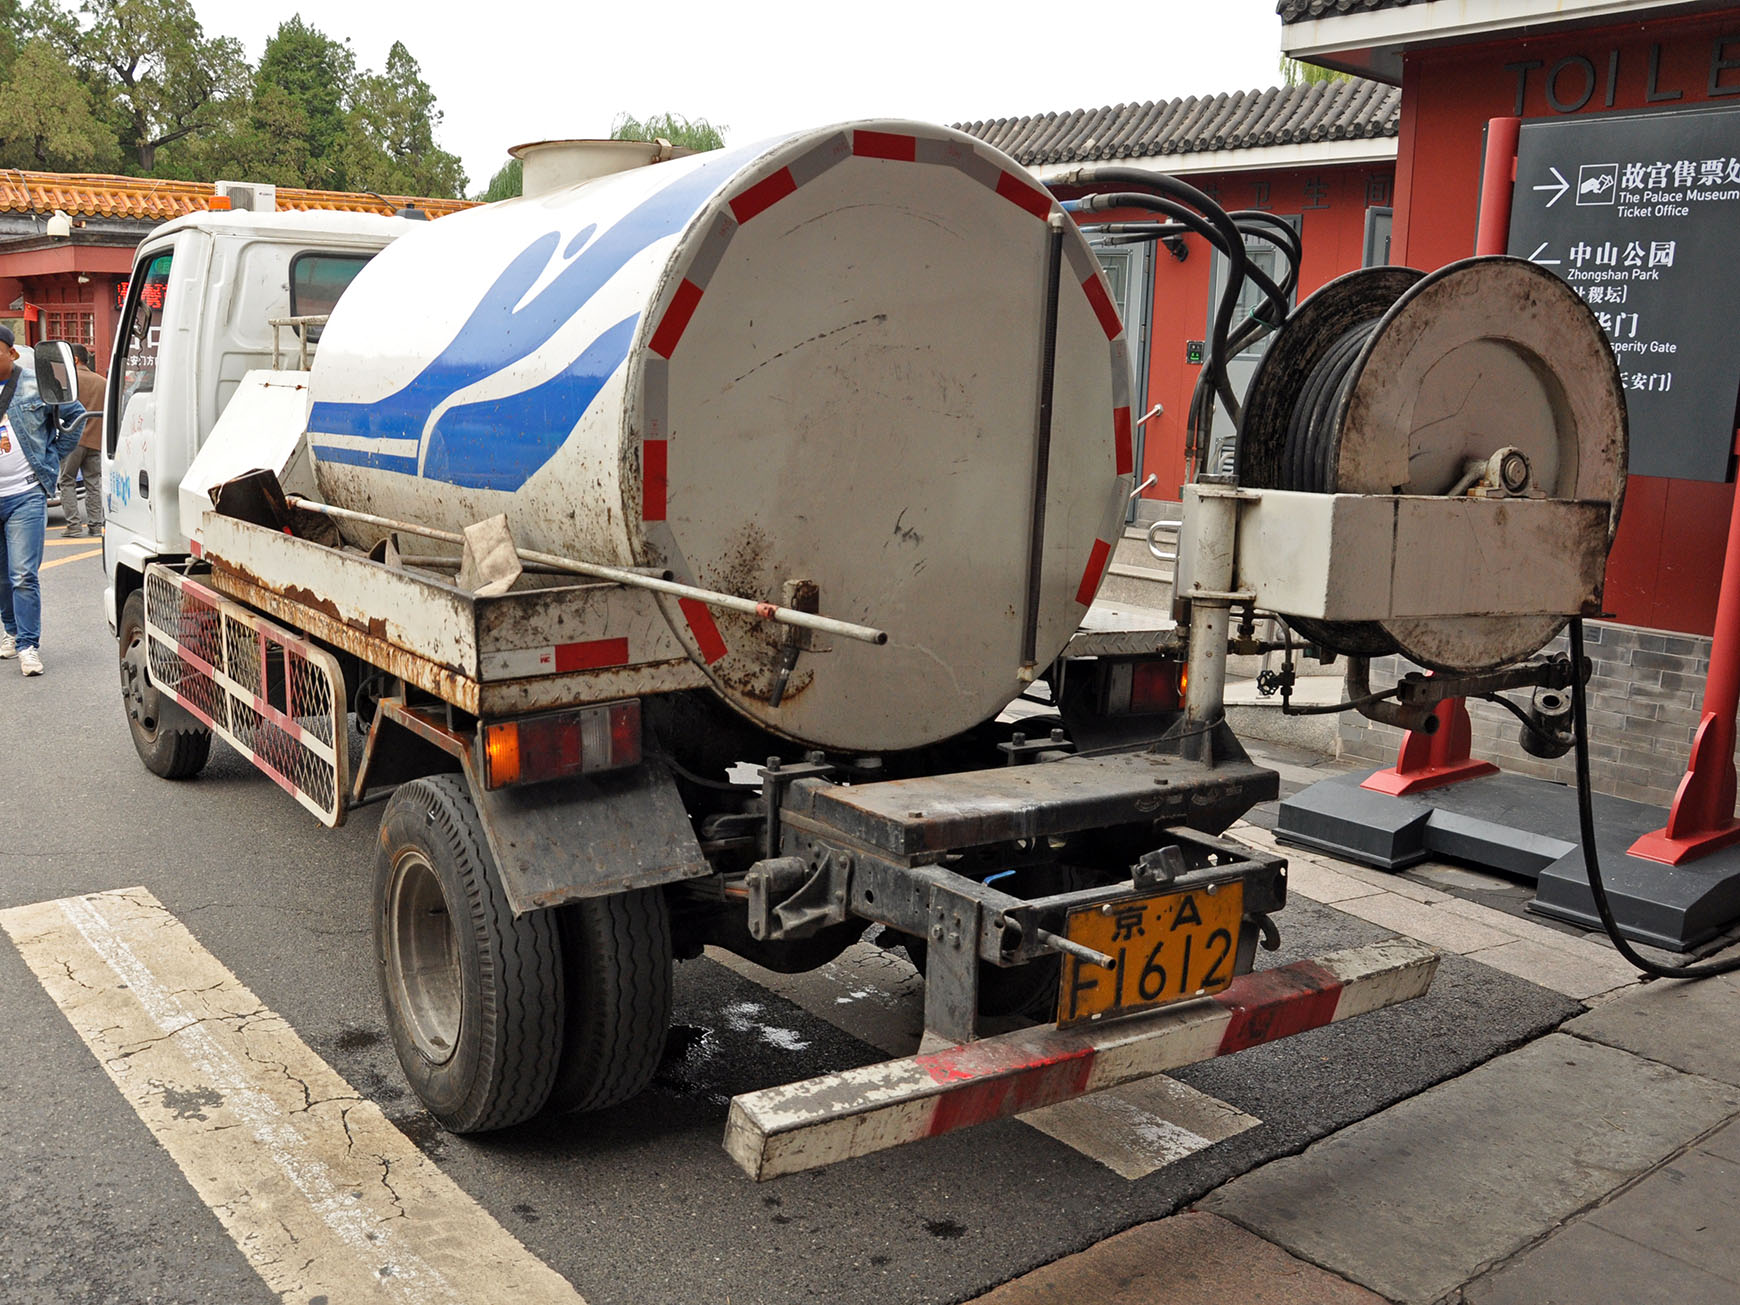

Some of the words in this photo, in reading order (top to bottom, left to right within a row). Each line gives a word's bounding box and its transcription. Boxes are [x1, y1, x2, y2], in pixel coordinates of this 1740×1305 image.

[1619, 192, 1640, 203] The
[1643, 191, 1682, 202] Palace
[1686, 189, 1740, 201] Museum
[1617, 206, 1652, 217] Ticket
[1655, 205, 1689, 216] Office
[1569, 240, 1676, 267] 中山公园
[1567, 269, 1628, 282] Zhongshan
[1632, 269, 1659, 280] Park
[1650, 341, 1677, 353] Gate
[1069, 928, 1232, 1020] F1612
